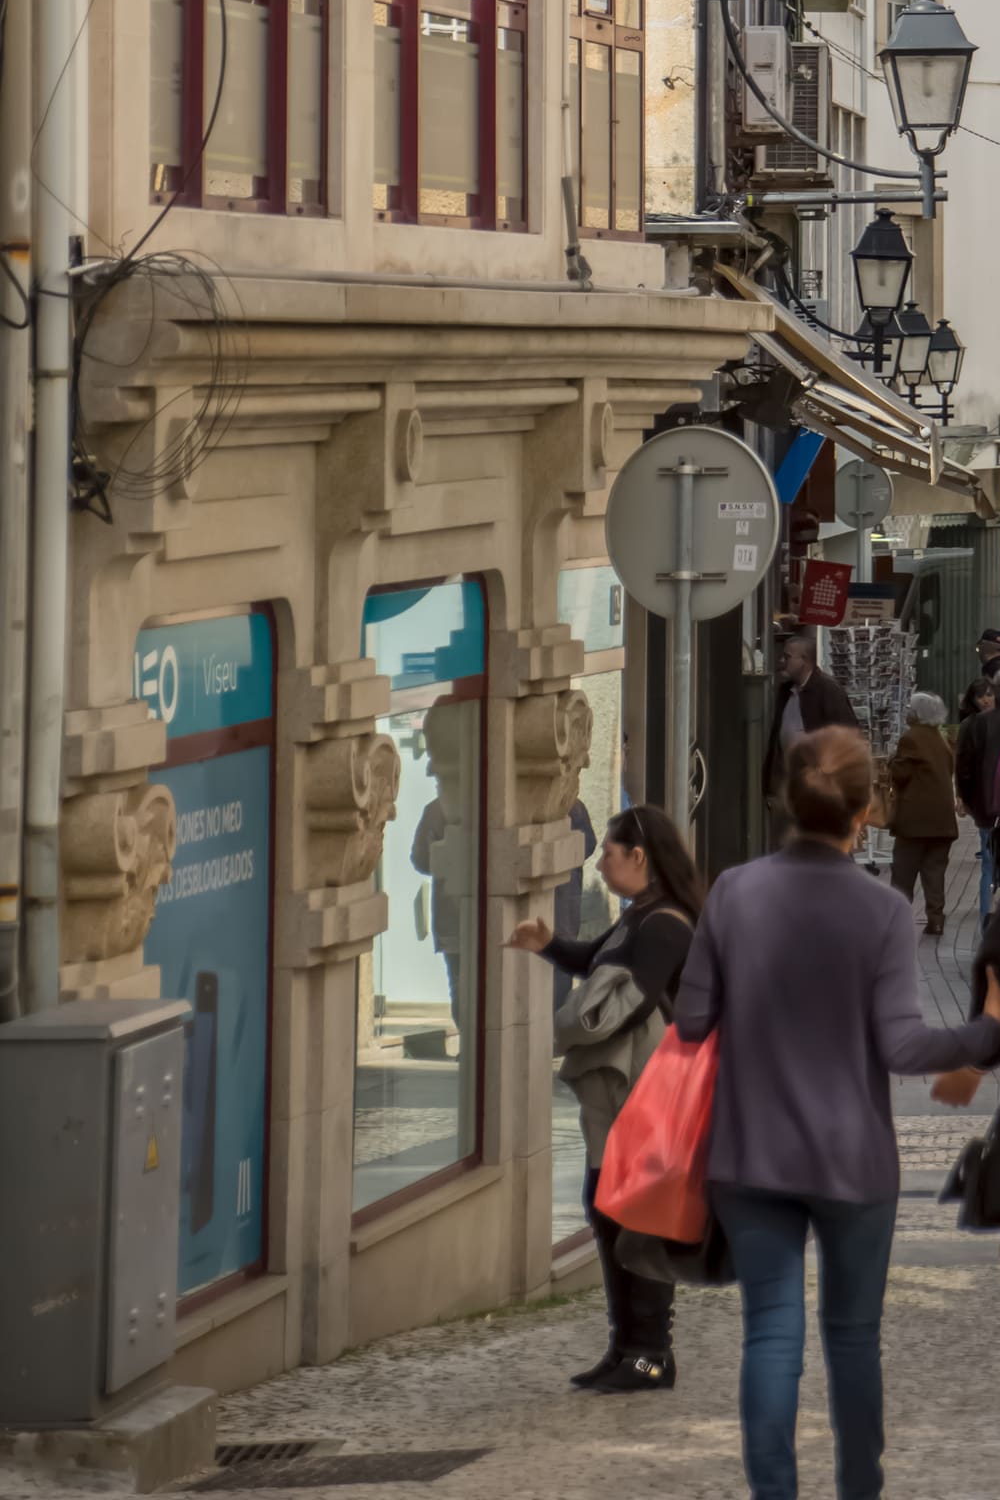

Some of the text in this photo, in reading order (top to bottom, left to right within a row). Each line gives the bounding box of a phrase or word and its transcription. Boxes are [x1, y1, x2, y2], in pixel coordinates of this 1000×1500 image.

[203, 653, 237, 696] Viseu
[222, 801, 243, 835] MEO
[175, 849, 254, 900] DESBLOQUEADOS
